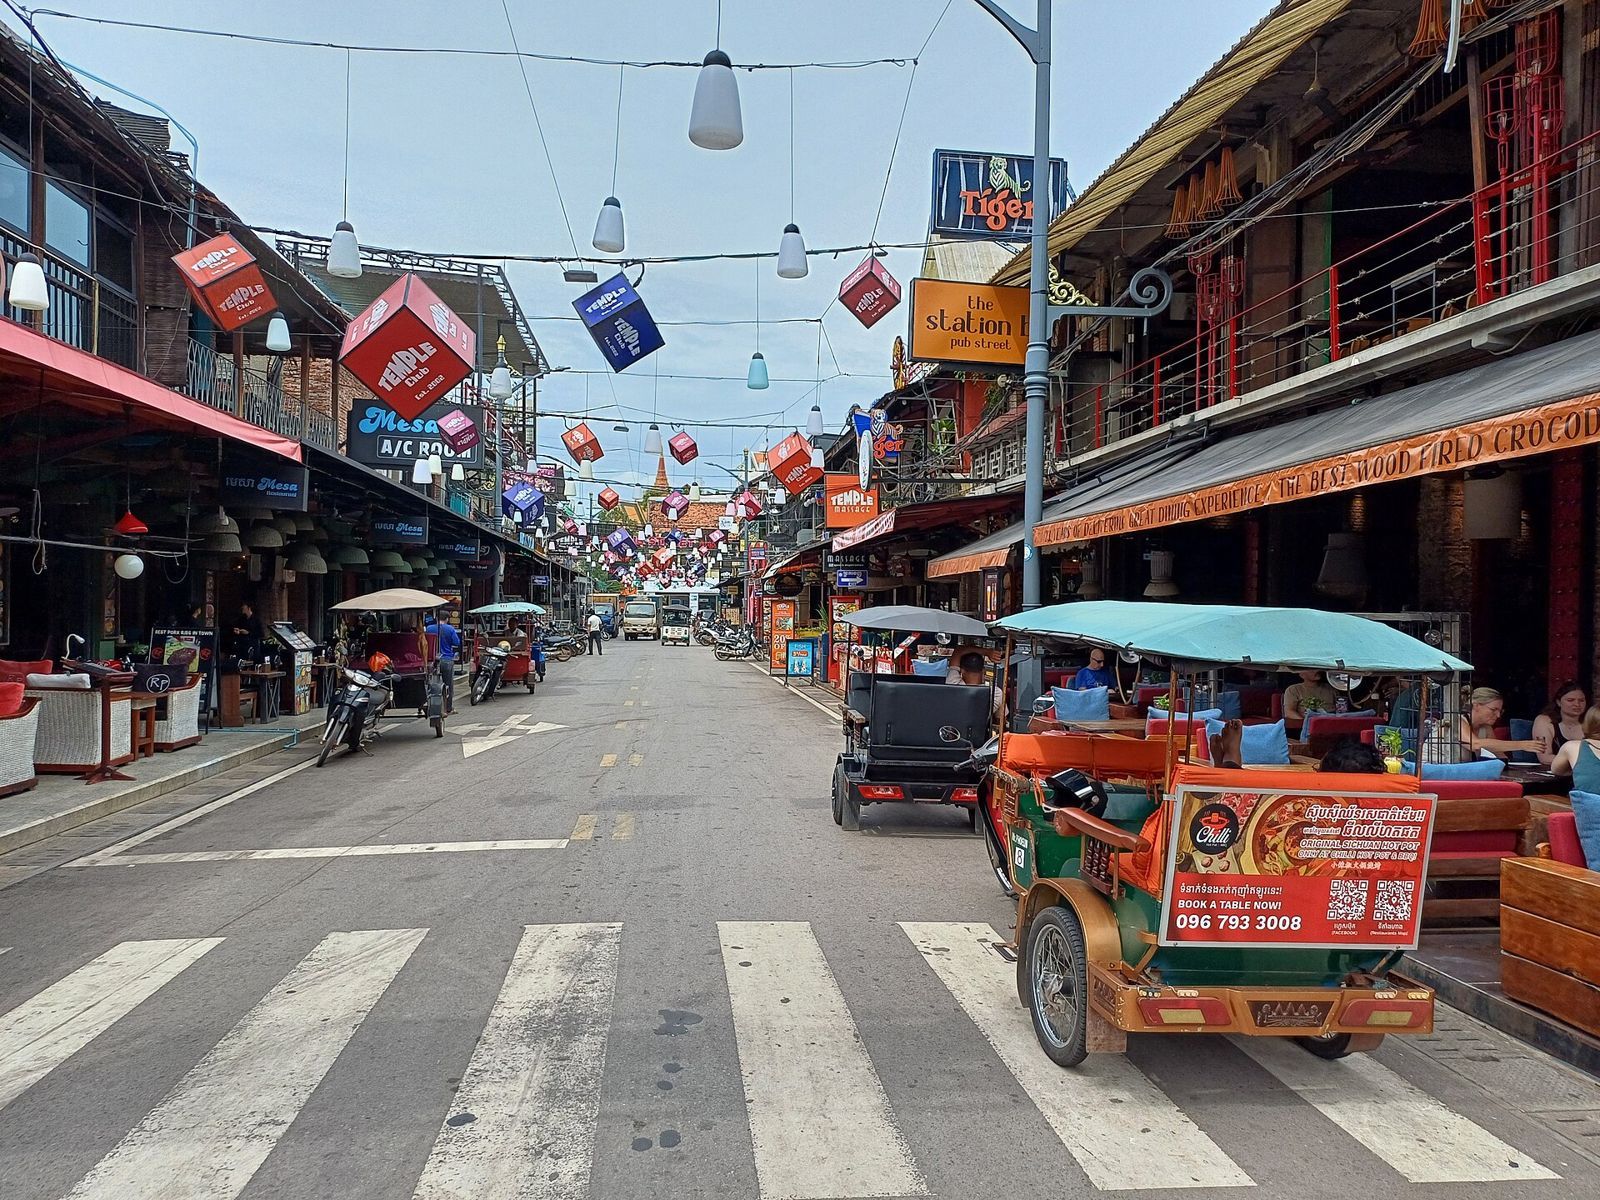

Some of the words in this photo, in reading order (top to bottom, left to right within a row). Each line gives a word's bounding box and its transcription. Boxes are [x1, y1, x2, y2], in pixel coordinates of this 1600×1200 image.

[960, 187, 1033, 230] Tiger
[191, 246, 238, 272] TEMPLE
[218, 284, 265, 312] TEMPLE
[236, 300, 254, 310] Club
[586, 287, 627, 313] TEMPLE
[856, 288, 884, 313] TEMPLE
[968, 296, 994, 311] the
[926, 309, 1012, 336] station
[614, 318, 640, 356] TEMPLE
[614, 332, 626, 350] Club
[950, 336, 974, 350] pub
[974, 338, 1012, 350] street
[378, 342, 438, 392] TEMPLE
[404, 366, 430, 388] Club
[414, 388, 429, 400] Est.
[358, 406, 440, 434] Mesa
[380, 440, 412, 458] A/C
[1073, 524, 1081, 538] OF
[1128, 508, 1156, 528] GREAT
[1194, 484, 1261, 516] EXPERIENCE
[1279, 476, 1304, 498] THE
[1310, 464, 1348, 492] BEST
[1357, 450, 1410, 483] WOOD
[1419, 434, 1482, 470] FIRED
[1494, 407, 1600, 454] CROCOD
[257, 477, 298, 491] Mesa
[830, 490, 874, 506] TEMPLE
[395, 522, 423, 532] Mesa
[827, 554, 865, 562] MASSAGE
[1196, 826, 1232, 843] Chilli
[1300, 839, 1342, 848] ORIGINAL
[1342, 840, 1381, 850] SICHUAN
[1381, 841, 1401, 850] HOT
[1401, 842, 1420, 852] POT
[1016, 850, 1022, 864] 8
[1298, 850, 1319, 859] ONLY
[1320, 850, 1330, 859] AT
[1330, 850, 1356, 860] CHILLI
[1356, 850, 1374, 860] HOT
[1374, 850, 1390, 860] POT
[1391, 851, 1398, 860] &
[1398, 852, 1418, 862] BBQ!
[1178, 900, 1207, 908] BOOK
[1210, 900, 1216, 909] A
[1220, 900, 1251, 910] TABLE
[1254, 902, 1282, 910] NOW!
[1176, 914, 1212, 929] 096
[1218, 914, 1250, 930] 793
[1255, 916, 1302, 930] 3008
